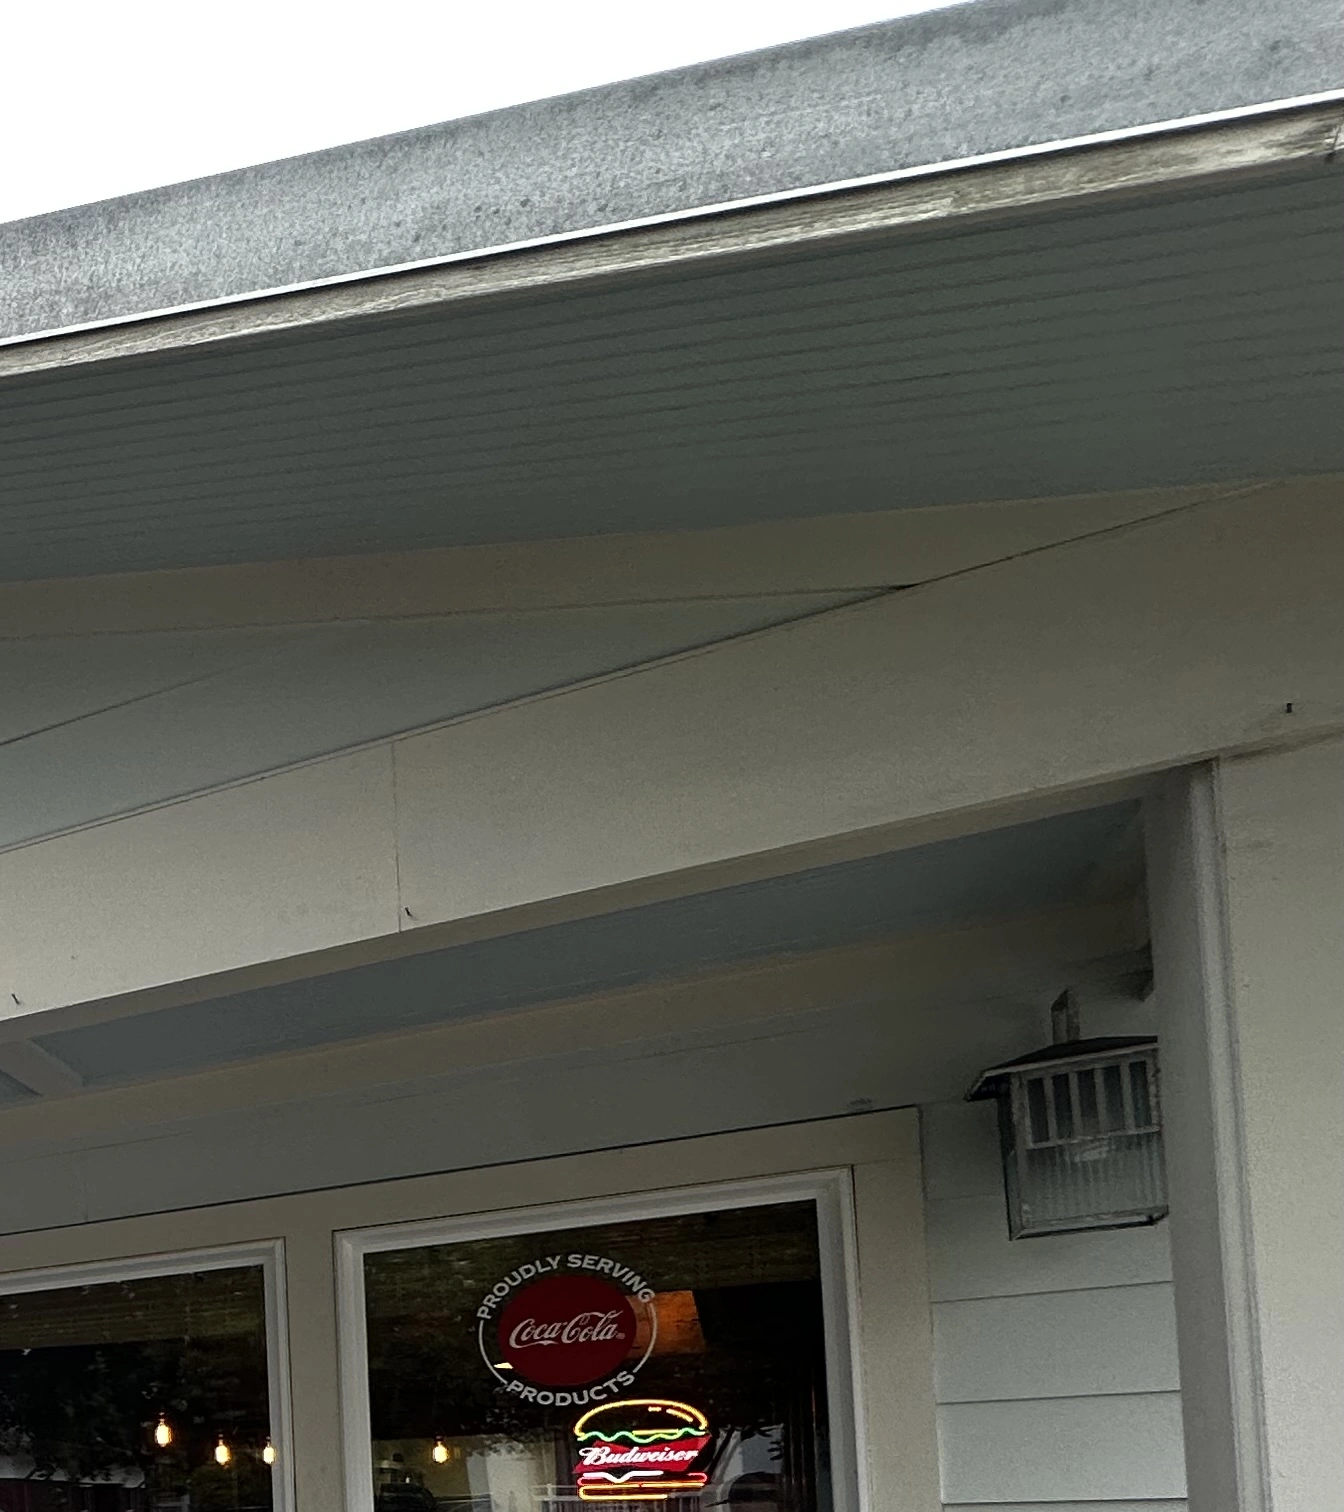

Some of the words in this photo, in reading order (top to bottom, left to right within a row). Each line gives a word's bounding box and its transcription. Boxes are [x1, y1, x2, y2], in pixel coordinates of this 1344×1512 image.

[476, 1254, 561, 1320] PROUDLY
[566, 1253, 657, 1304] SERVING
[509, 1309, 625, 1349] Coca-Cola
[506, 1370, 635, 1407] PRODUCTS
[578, 1445, 699, 1467] Budweiser
